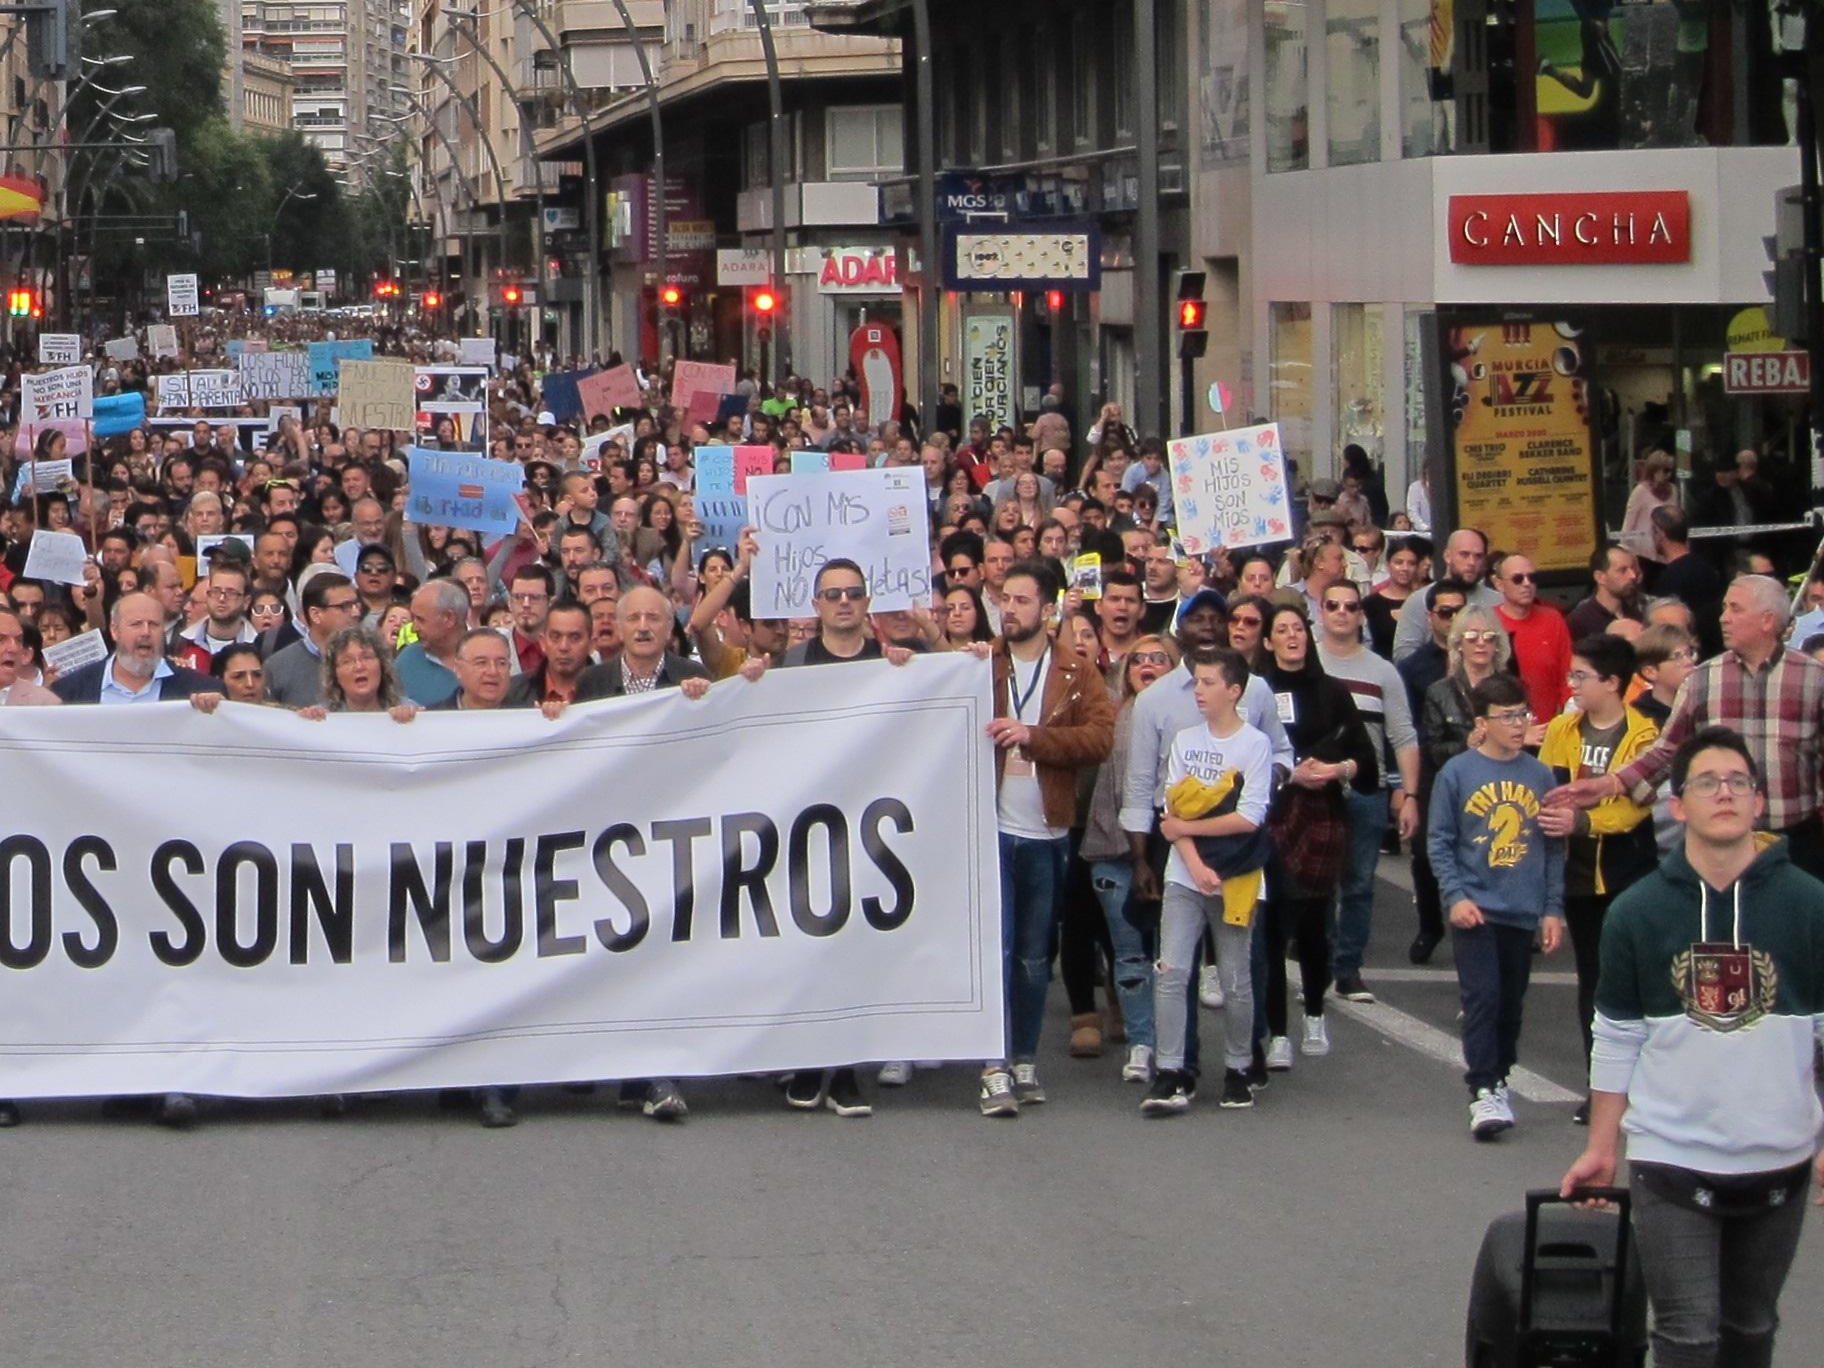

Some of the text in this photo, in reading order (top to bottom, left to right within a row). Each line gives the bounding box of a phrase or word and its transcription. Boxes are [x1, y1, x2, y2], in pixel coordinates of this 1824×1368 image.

[947, 194, 987, 208] MGS
[1464, 210, 1672, 247] CANCHA
[721, 262, 768, 273] ADARA
[1491, 358, 1551, 372] MURCIA
[1481, 371, 1554, 407] JAZZ
[1493, 404, 1553, 418] FESTIVAL
[1204, 473, 1252, 493] HIJOS
[1215, 490, 1247, 512] SON
[774, 577, 810, 611] NO
[1184, 749, 1225, 766] UNITED
[1463, 782, 1499, 818] TRY
[148, 838, 354, 968] SON
[387, 796, 916, 965] NUESTROS
